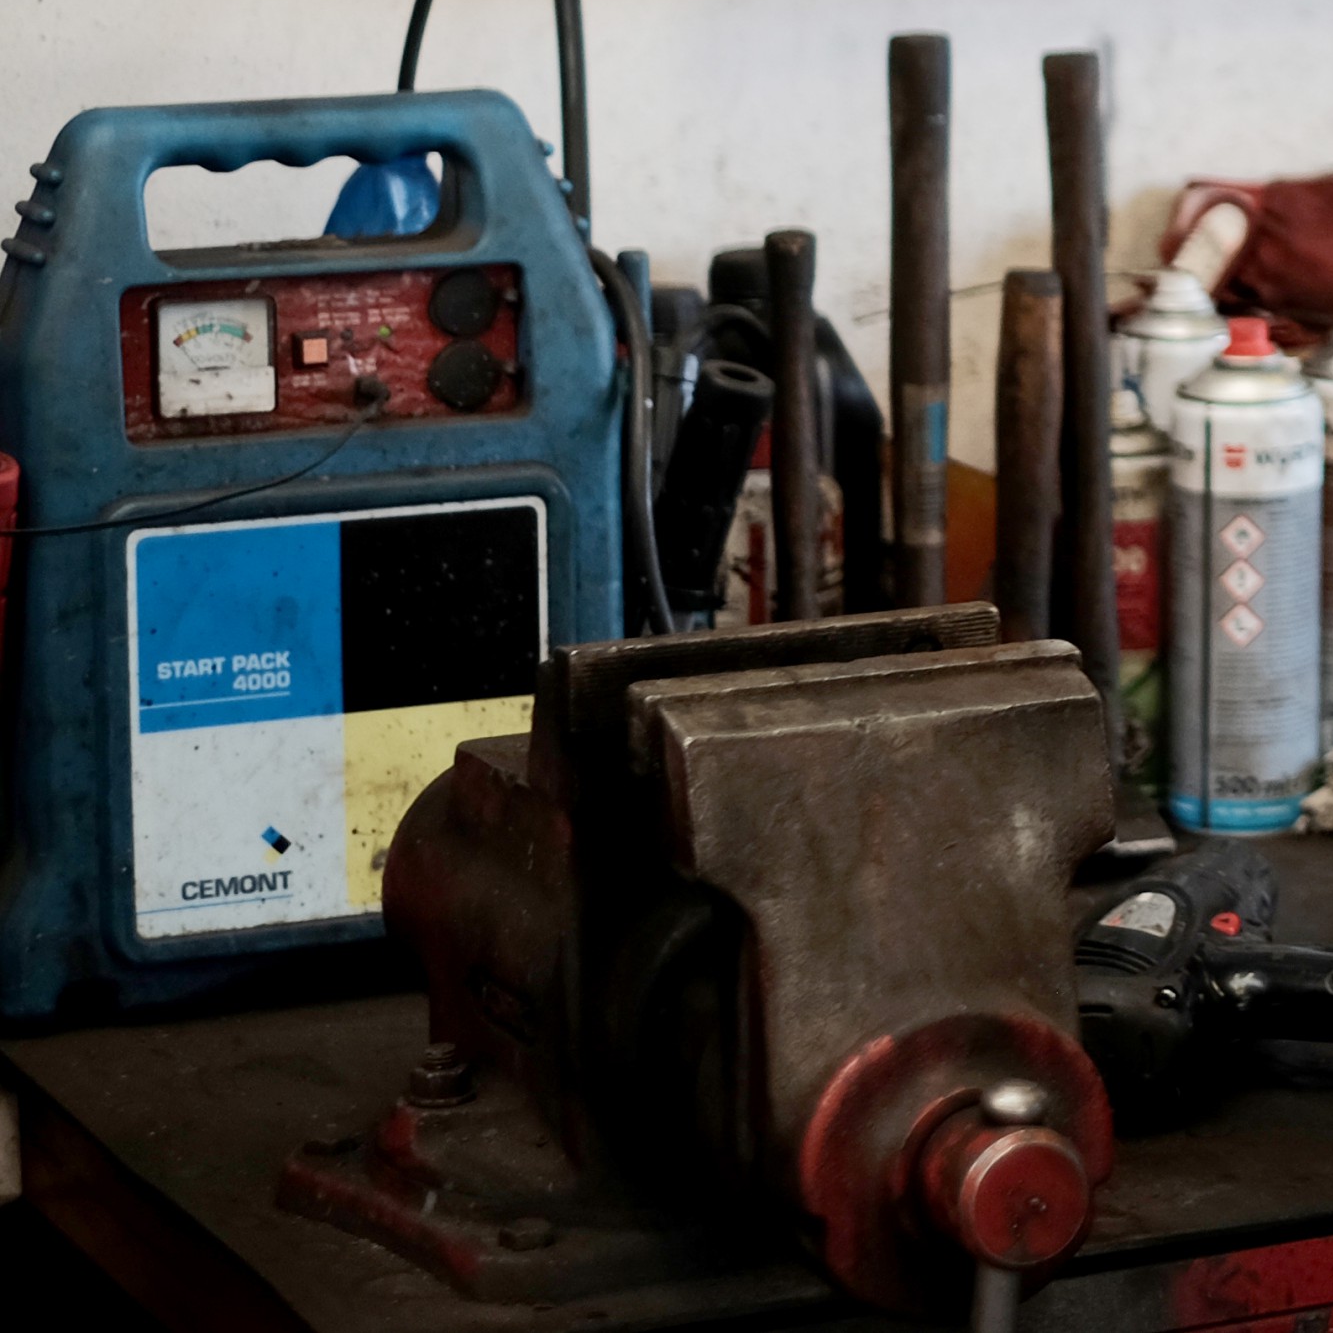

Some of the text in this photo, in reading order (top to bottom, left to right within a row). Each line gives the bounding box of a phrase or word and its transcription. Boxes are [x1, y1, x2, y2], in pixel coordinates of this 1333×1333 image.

[157, 650, 291, 680] START PACK
[233, 671, 291, 691] 4000
[181, 870, 293, 901] CEMONT
